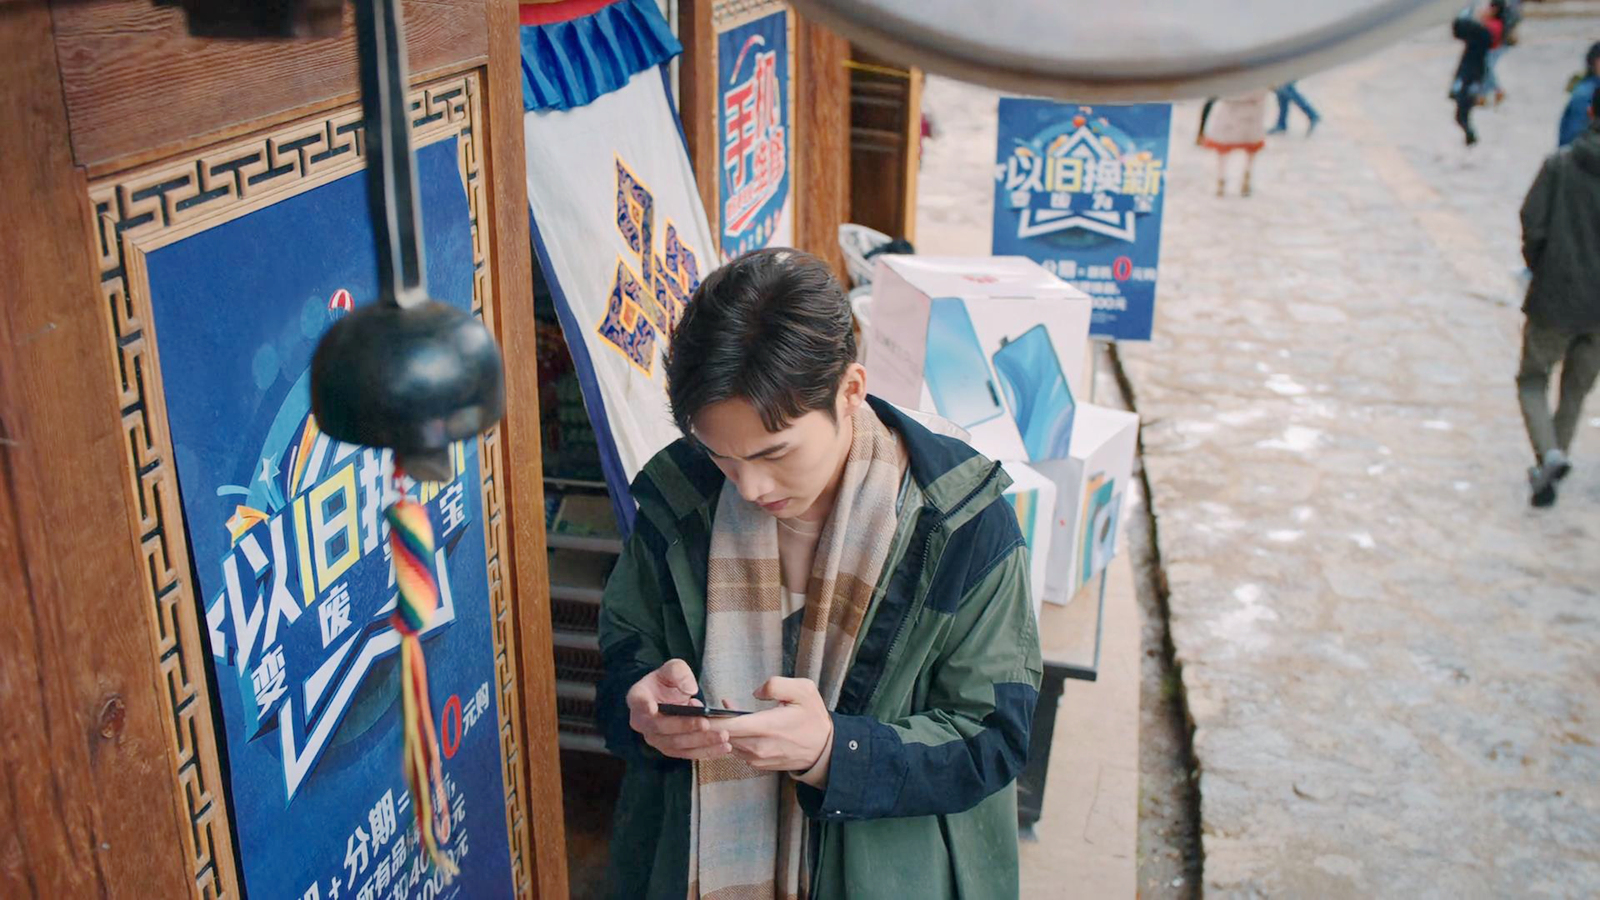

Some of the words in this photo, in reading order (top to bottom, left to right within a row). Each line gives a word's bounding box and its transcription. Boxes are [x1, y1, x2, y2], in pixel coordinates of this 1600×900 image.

[1004, 155, 1163, 196] 以旧换新
[223, 439, 466, 679] 以旧换
